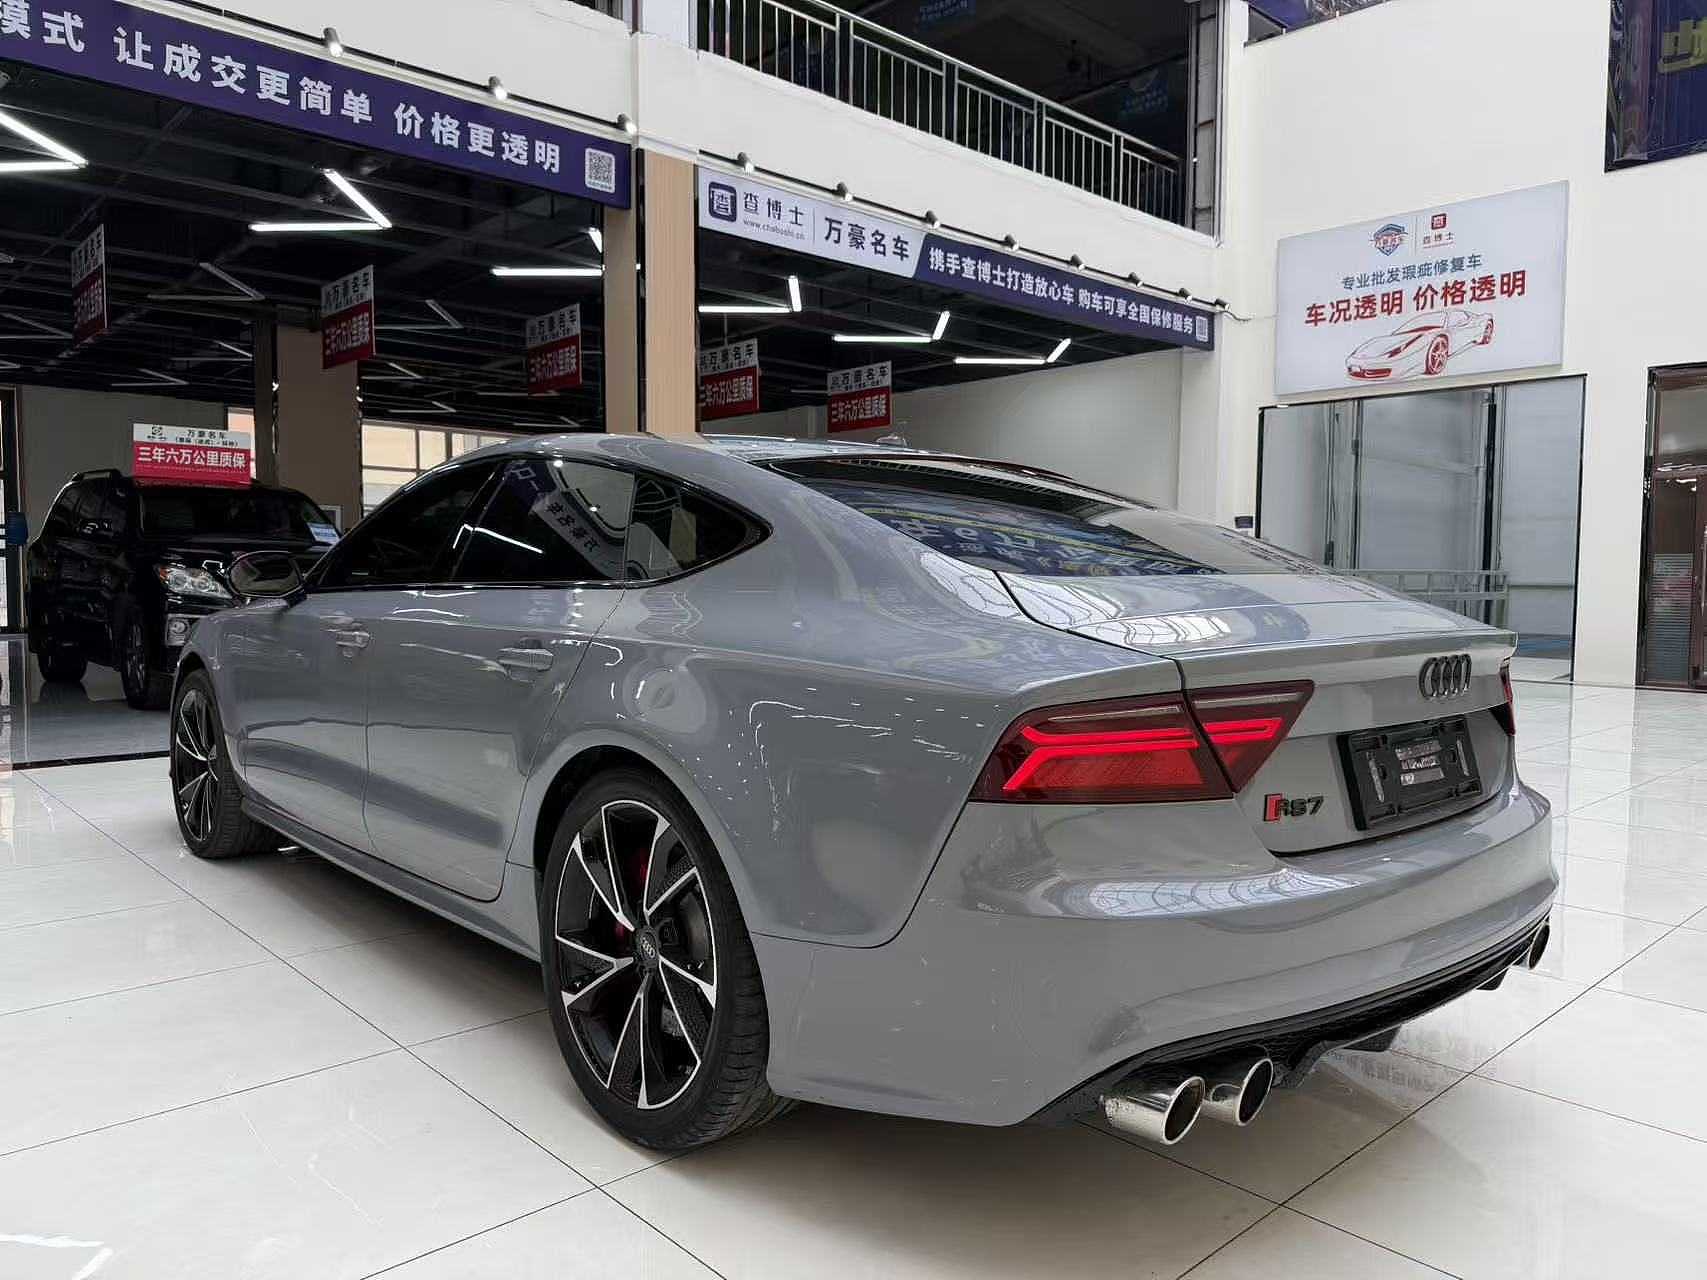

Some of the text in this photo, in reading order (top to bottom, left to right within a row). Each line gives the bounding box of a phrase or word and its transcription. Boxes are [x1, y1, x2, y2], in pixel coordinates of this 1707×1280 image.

[112, 28, 374, 125] 让成交更简单
[394, 101, 561, 174] 价格更透明
[743, 191, 909, 260] 查博士 万豪名车
[929, 246, 1193, 334] 携手查博士打造放心车 购车可享全国保修服务
[1304, 269, 1527, 327] 车况透明 价格透明
[1341, 253, 1483, 291] 专业批发瑕疵修复车
[137, 446, 246, 469] 三年六万公里质保
[1264, 793, 1324, 822] RS7
